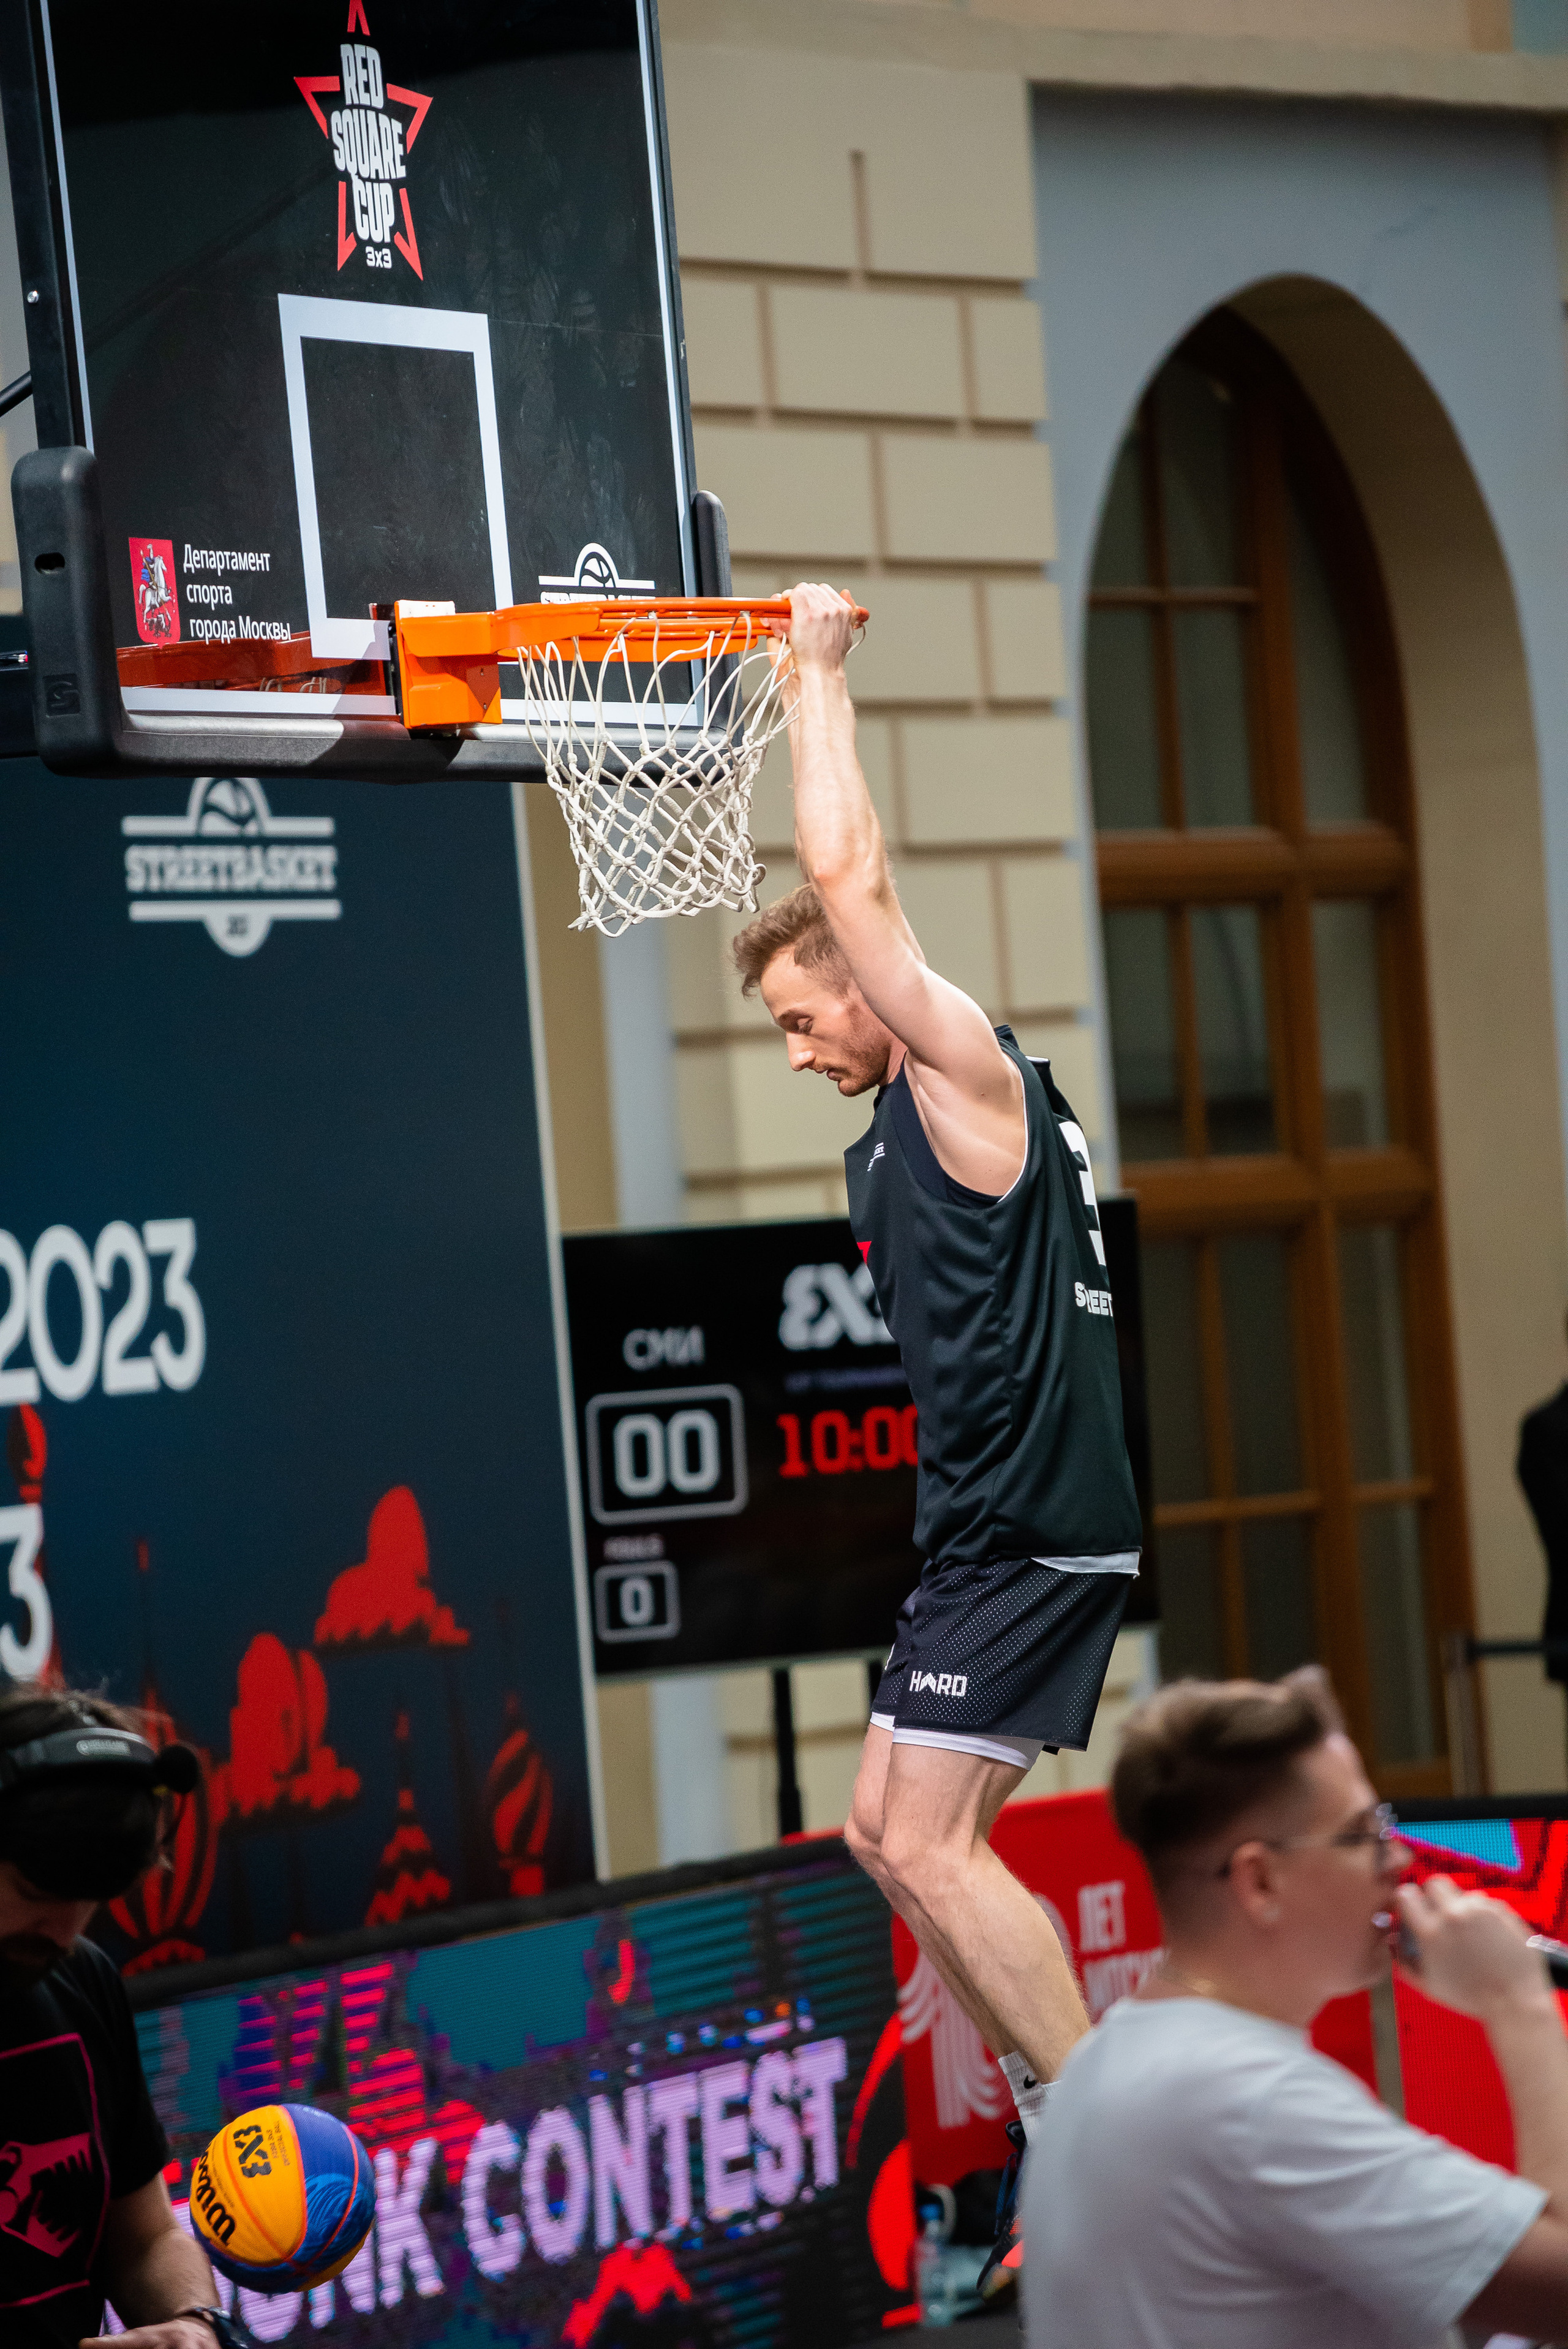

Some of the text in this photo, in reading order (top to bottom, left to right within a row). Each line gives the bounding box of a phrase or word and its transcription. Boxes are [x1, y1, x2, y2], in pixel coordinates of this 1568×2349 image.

[340, 44, 384, 109] RED
[331, 108, 406, 180] SQUARE
[353, 181, 394, 243] CUP
[184, 543, 270, 576] Департамент
[186, 583, 232, 610] спорта
[189, 615, 292, 645] города Москвы
[0, 1217, 206, 1404] 2023
[613, 1409, 721, 1498] 00
[620, 1577, 654, 1626] 0
[462, 2038, 848, 2279] CONTEST
